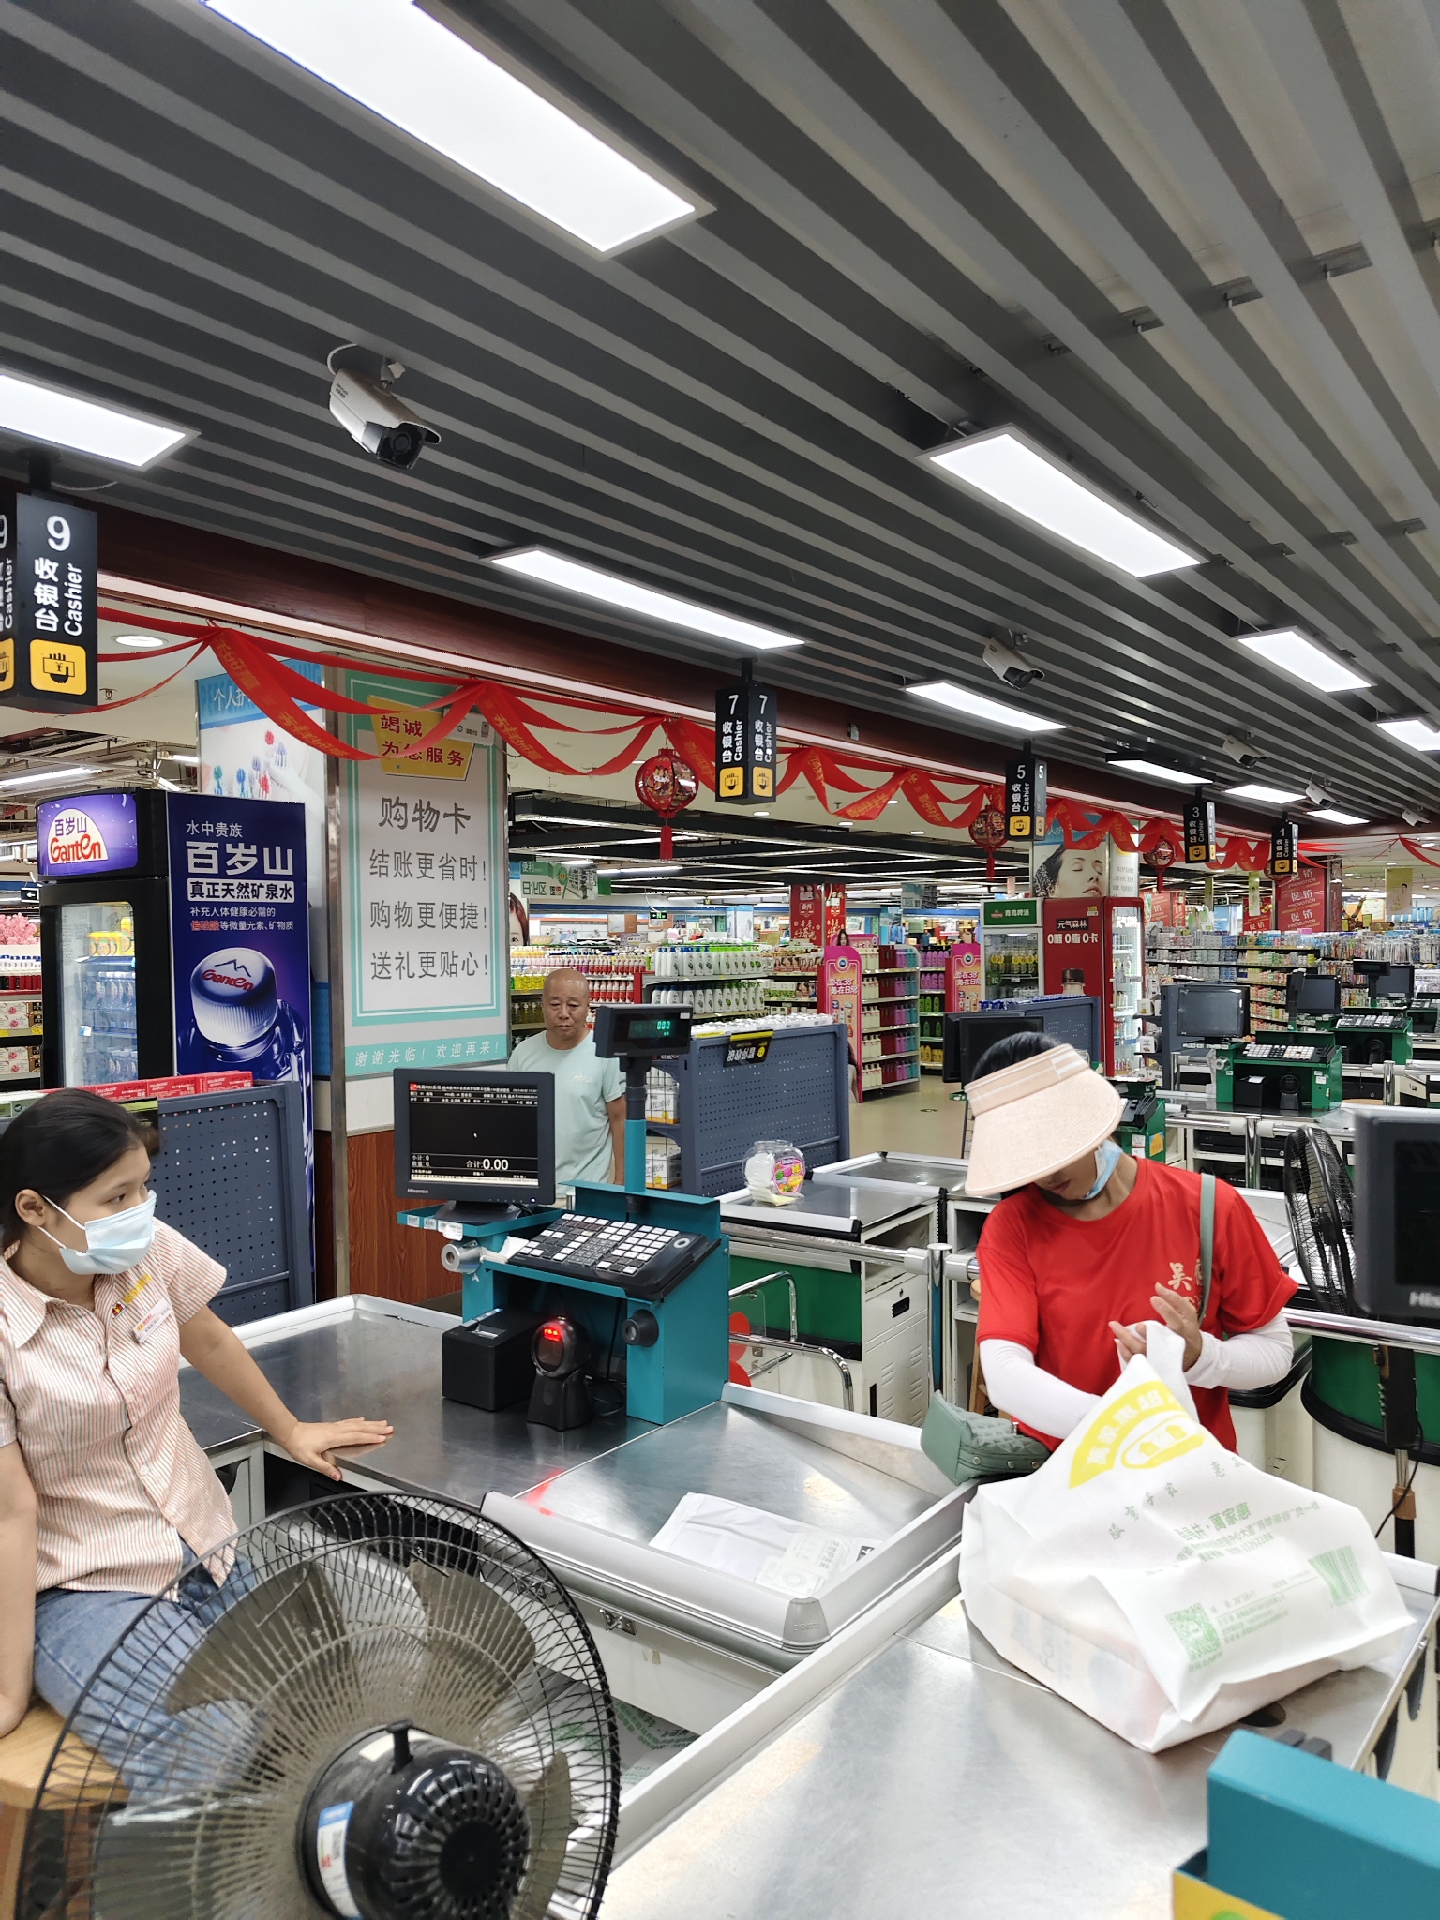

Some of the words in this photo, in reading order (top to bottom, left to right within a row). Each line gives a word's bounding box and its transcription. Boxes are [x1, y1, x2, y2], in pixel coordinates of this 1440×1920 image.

[47, 515, 71, 551] 9
[5, 558, 13, 629] Cashier
[34, 557, 59, 632] 收银台
[64, 563, 83, 637] Cashier
[213, 685, 250, 712] 个人护
[728, 695, 739, 715] 7
[758, 695, 768, 715] 7
[381, 715, 423, 737] 竭诚
[754, 719, 764, 761] 收银台
[722, 721, 733, 763] 收银台
[733, 720, 743, 761] Cashier
[764, 722, 773, 763] Cashier
[1016, 765, 1026, 779] 5
[1011, 783, 1022, 813] 收银台
[1022, 782, 1030, 812] Cashier
[379, 796, 471, 834] 购物卡
[1192, 806, 1200, 818] 3
[54, 816, 88, 837] 百岁山
[186, 819, 243, 838] 水中贵族
[1189, 820, 1198, 843] 收银台
[1280, 828, 1285, 836] 1
[51, 833, 102, 863] Ganten
[186, 840, 293, 876] 百岁山
[368, 848, 487, 881] 结账更省时！
[189, 880, 293, 900] 真正天然矿泉水
[1288, 898, 1316, 908] PROMOTION
[189, 906, 276, 918] 补充人体健康必需的
[369, 900, 487, 930] 购物更便捷！
[1057, 920, 1088, 929] 元气森林
[202, 969, 254, 991] Ganten
[370, 951, 488, 981] 送礼更贴心！
[483, 1158, 509, 1171] 0.00
